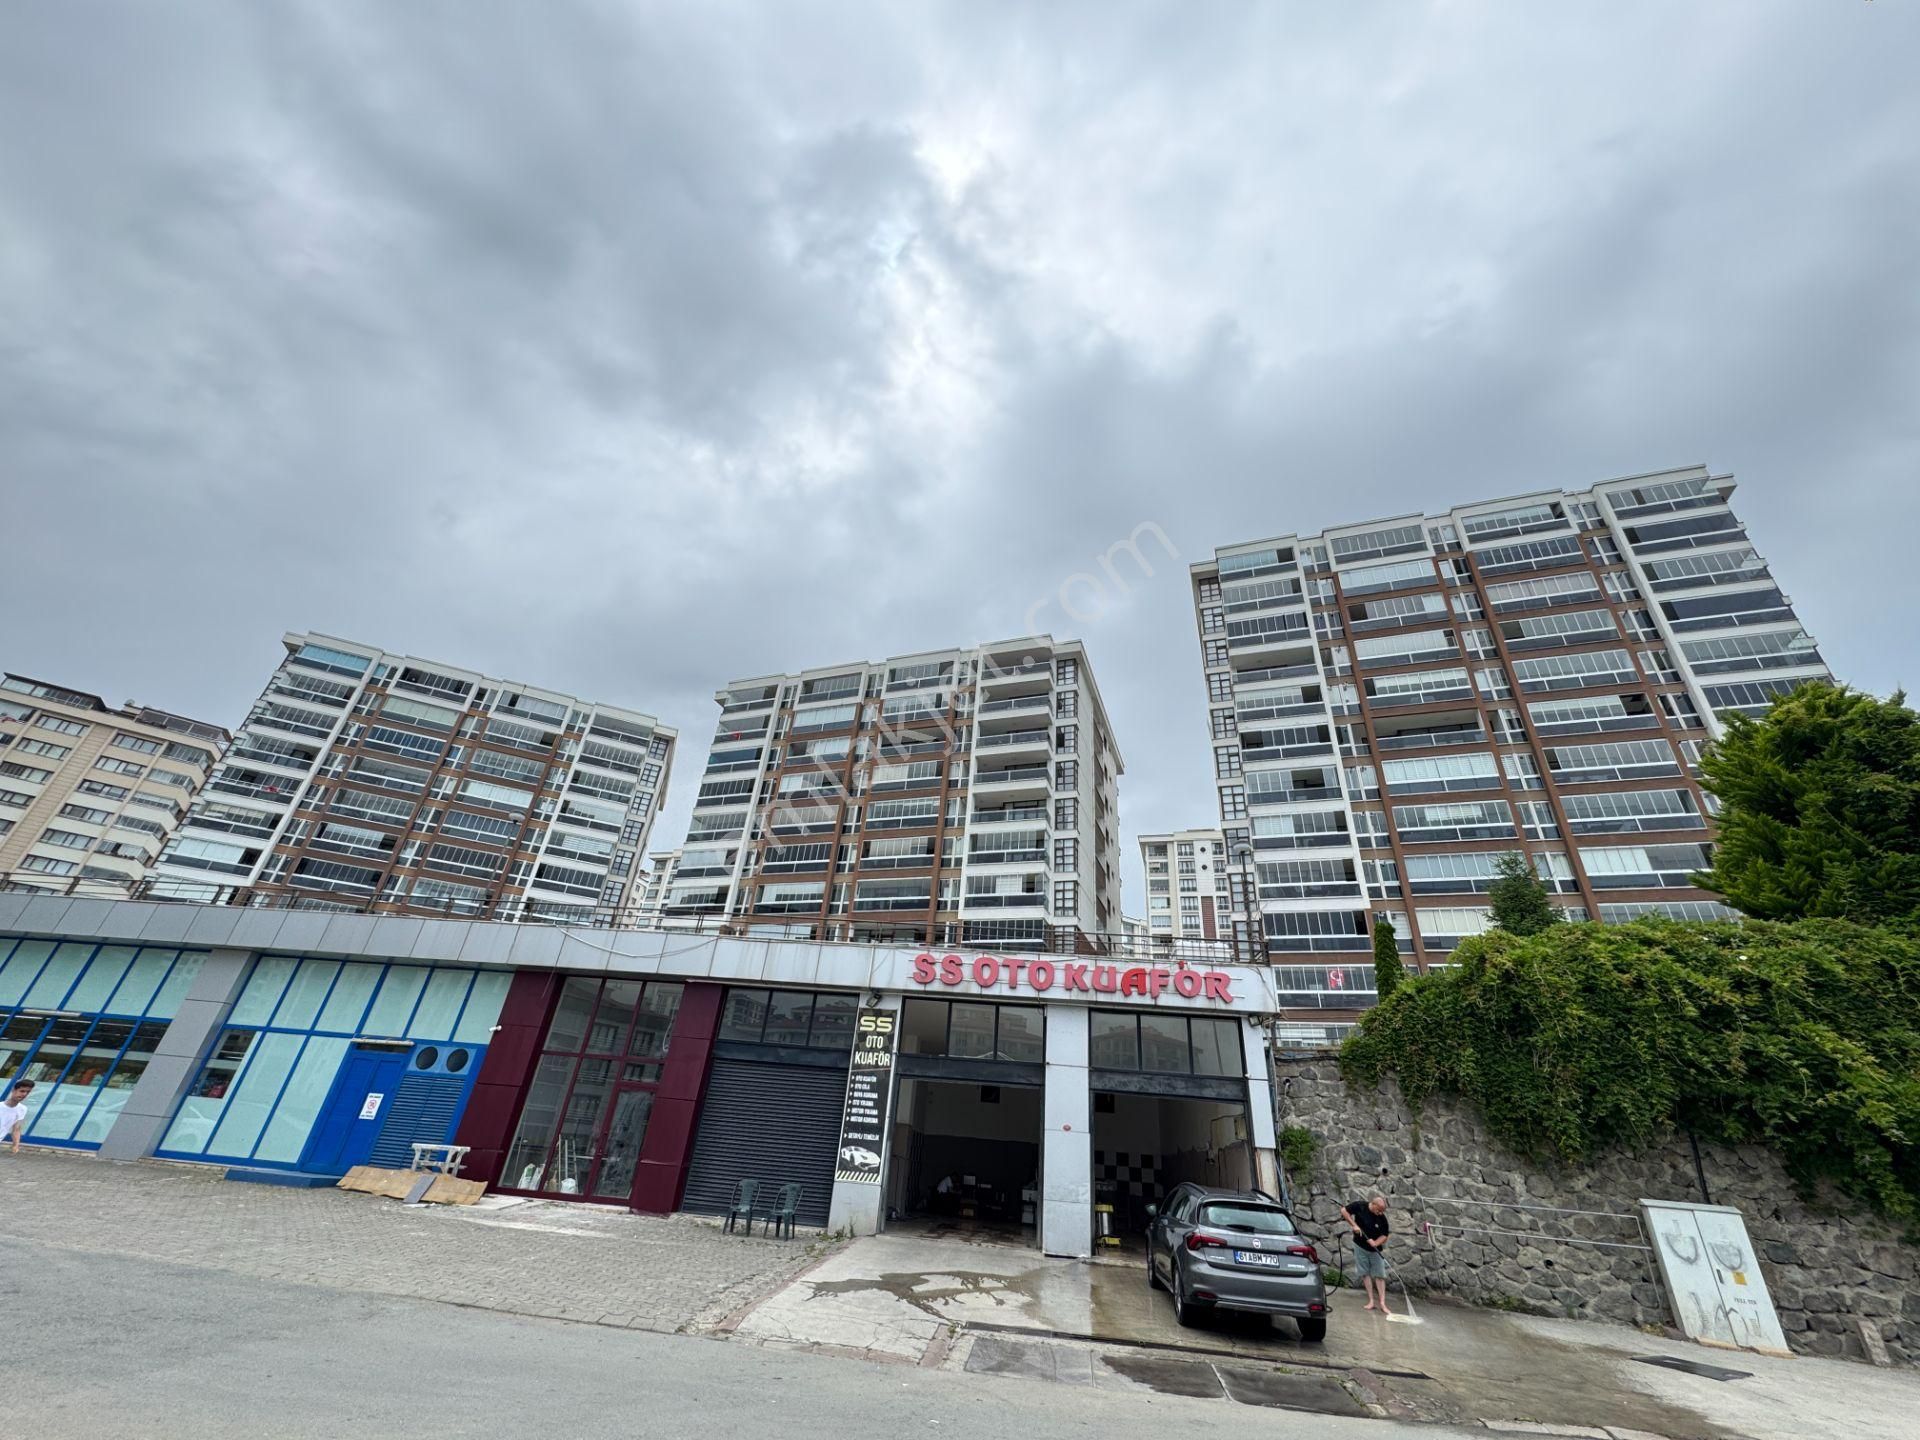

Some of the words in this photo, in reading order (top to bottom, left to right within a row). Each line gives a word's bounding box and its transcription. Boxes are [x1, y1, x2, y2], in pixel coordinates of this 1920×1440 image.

[972, 956, 1055, 991] OTO
[860, 1015, 893, 1032] SS
[866, 1035, 883, 1049] OTO
[854, 1050, 890, 1067] KUAFÖR
